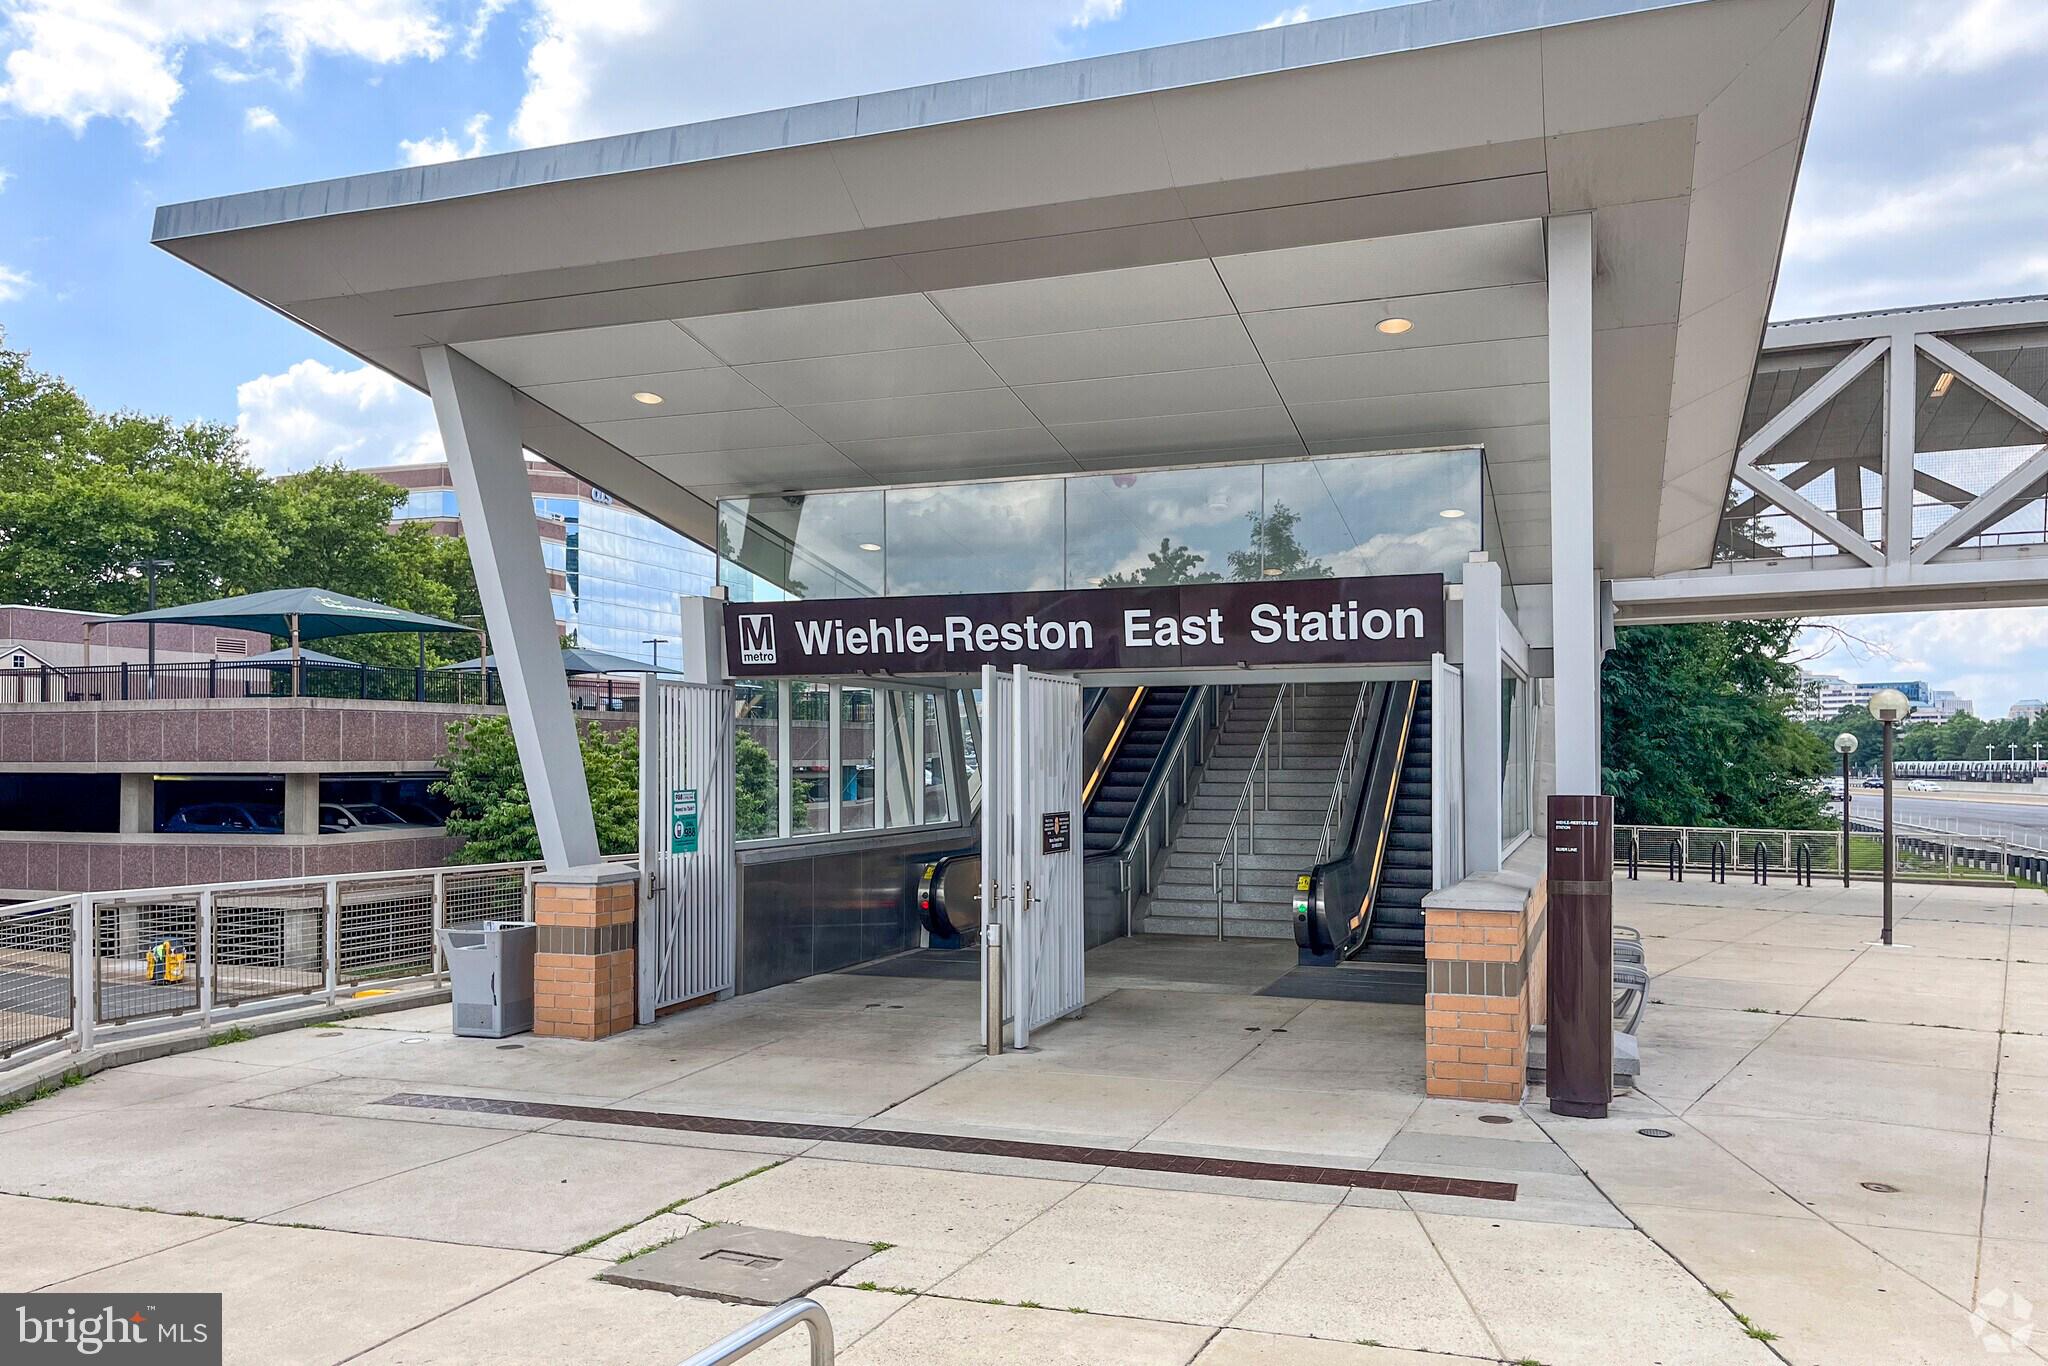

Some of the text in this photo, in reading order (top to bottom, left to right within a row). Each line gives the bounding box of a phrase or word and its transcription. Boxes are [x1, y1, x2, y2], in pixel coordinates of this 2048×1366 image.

[742, 616, 773, 650] M
[795, 600, 1424, 655] Wiehle-Reston East Station
[744, 651, 774, 662] metro
